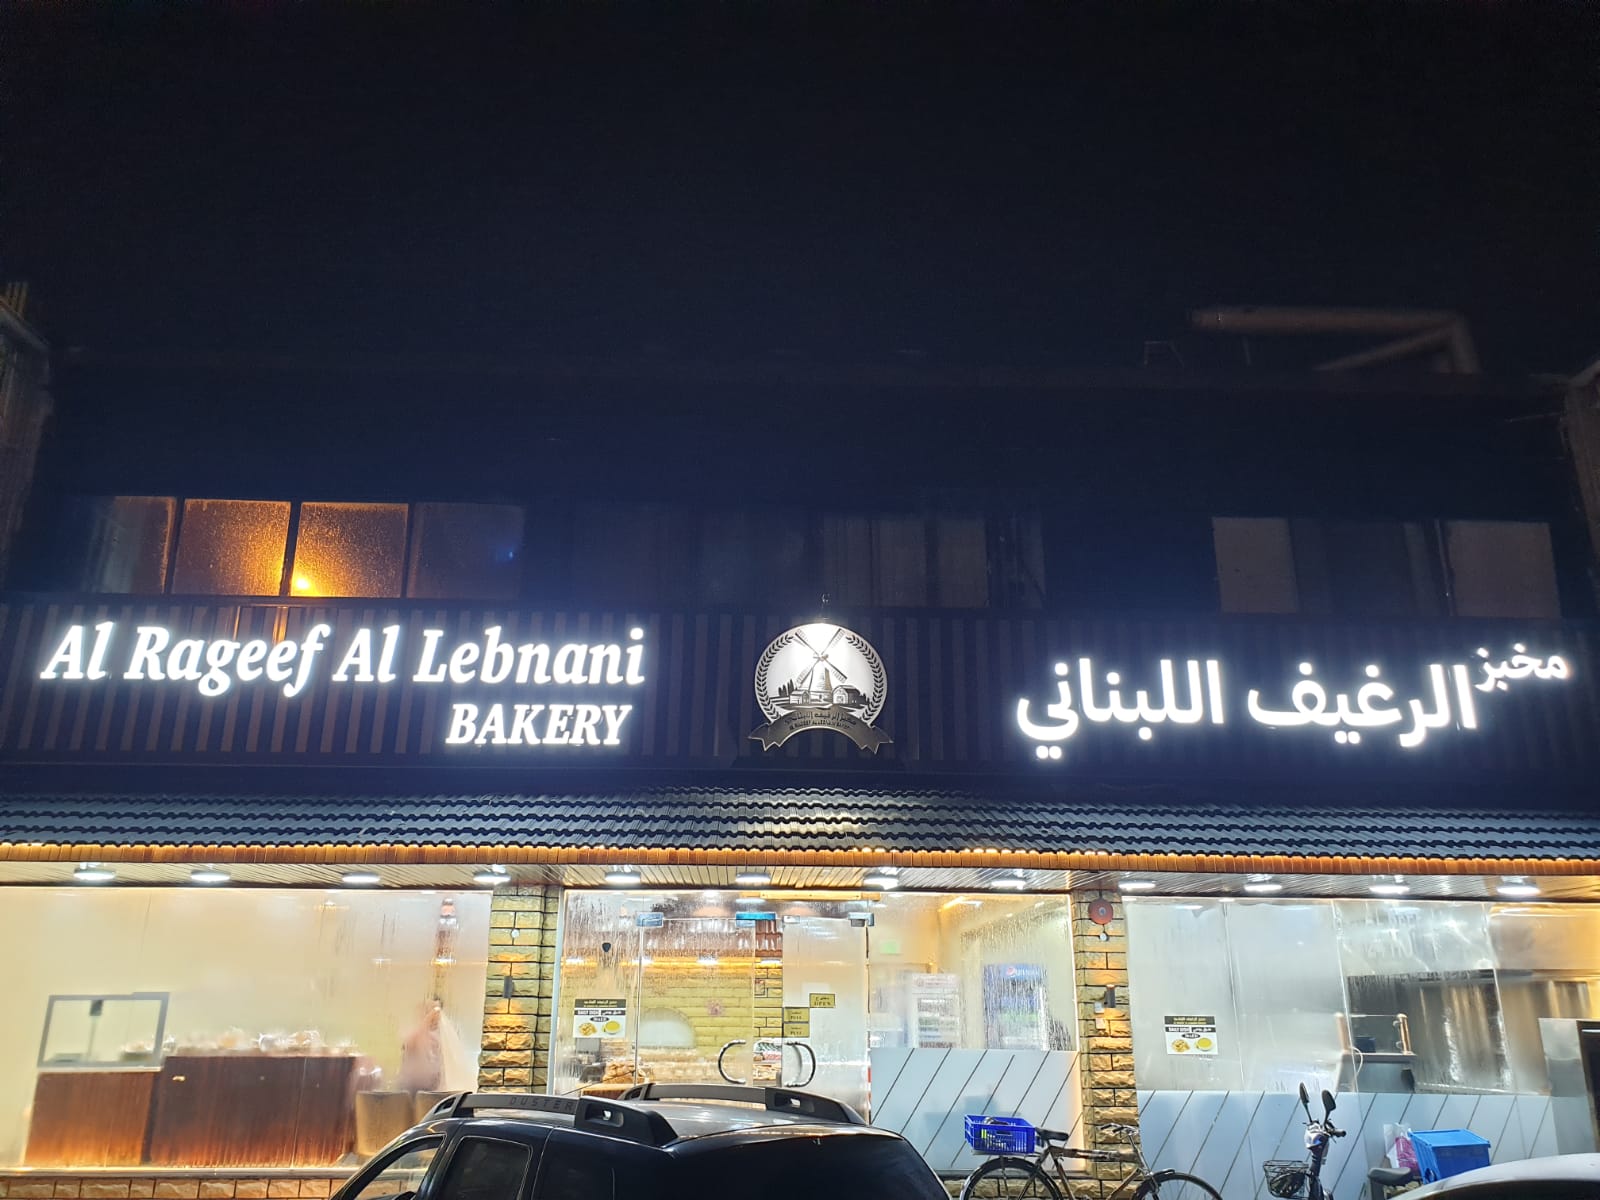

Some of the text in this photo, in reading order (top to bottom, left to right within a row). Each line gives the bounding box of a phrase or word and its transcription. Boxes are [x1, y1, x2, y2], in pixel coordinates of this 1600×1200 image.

[39, 621, 646, 698] Al Rageef Al Lebnani
[445, 702, 633, 746] BAKERY
[1016, 643, 1570, 760] مخبز الرغيف اللبناني
[509, 1096, 574, 1111] DUSTER
